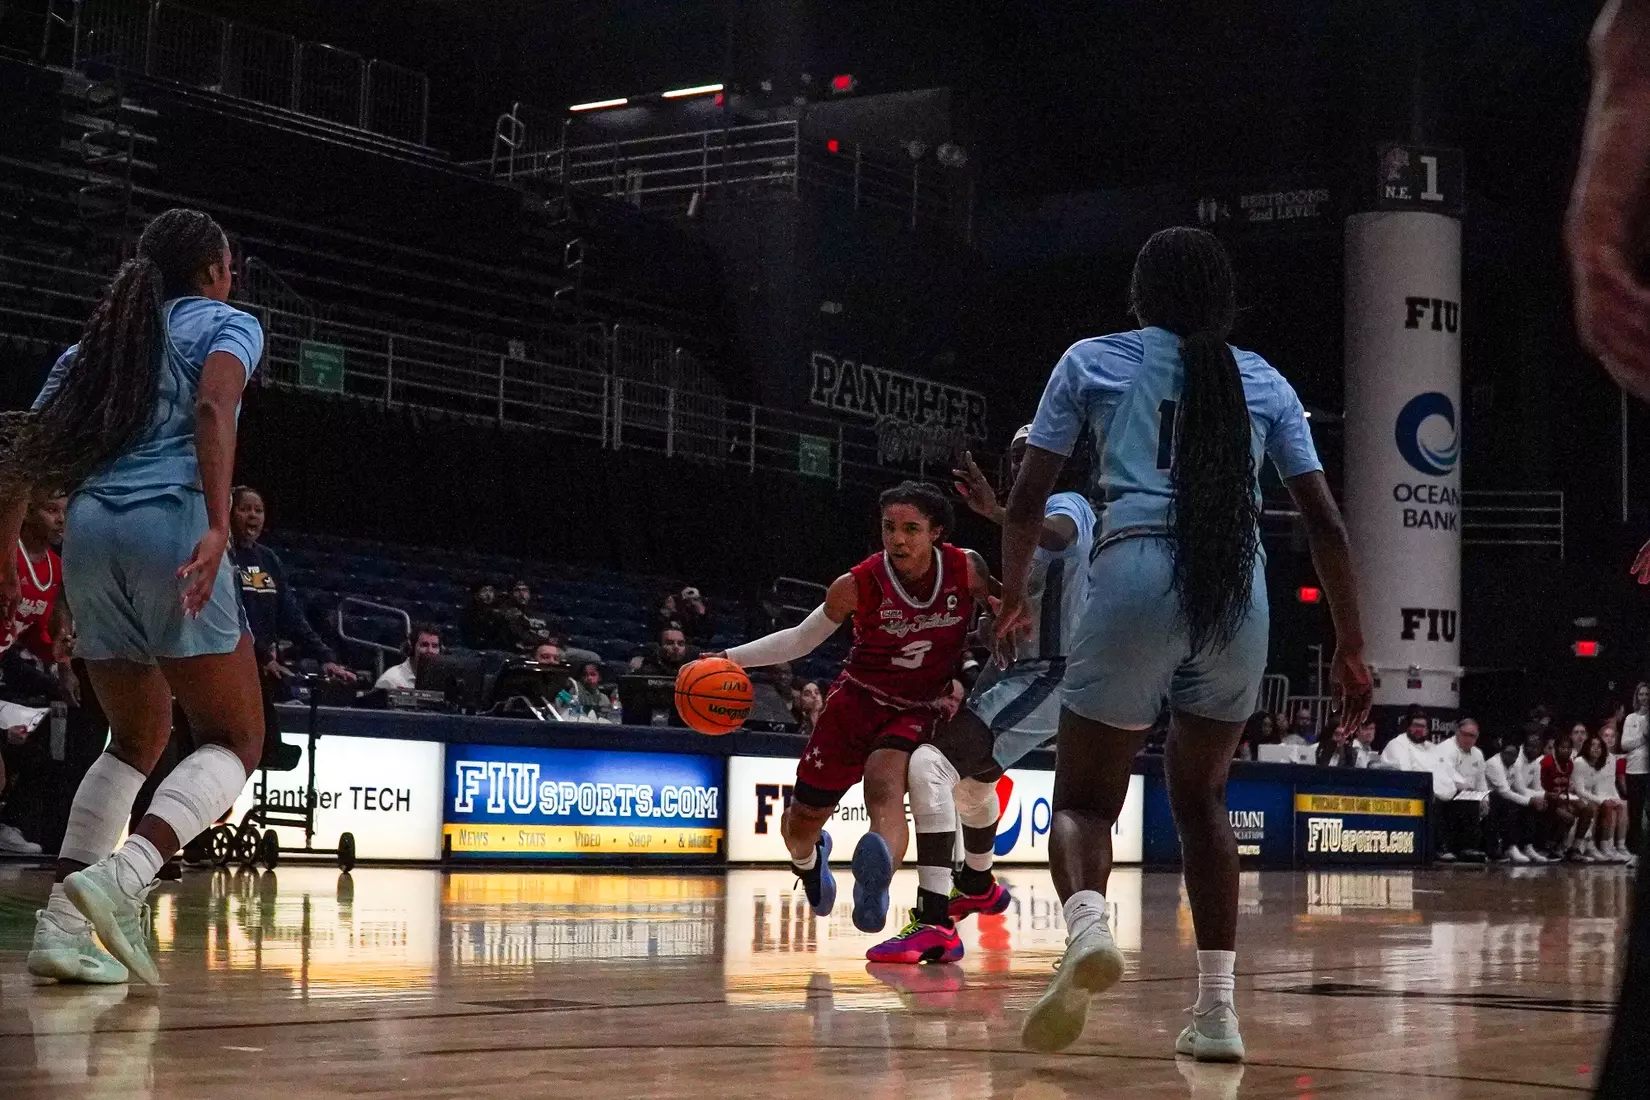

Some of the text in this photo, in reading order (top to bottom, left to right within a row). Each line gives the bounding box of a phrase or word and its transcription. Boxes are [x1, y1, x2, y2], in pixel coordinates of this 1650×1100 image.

[1420, 156, 1444, 201] 1
[1385, 185, 1412, 200] N.E.
[1404, 296, 1459, 333] FIU
[810, 352, 988, 440] PANTHER
[1393, 483, 1461, 506] OCEAN
[1403, 508, 1458, 531] BANK
[1400, 607, 1457, 643] FIU
[891, 640, 933, 669] 3
[350, 786, 411, 811] TECH
[1228, 810, 1265, 828] LUMNI
